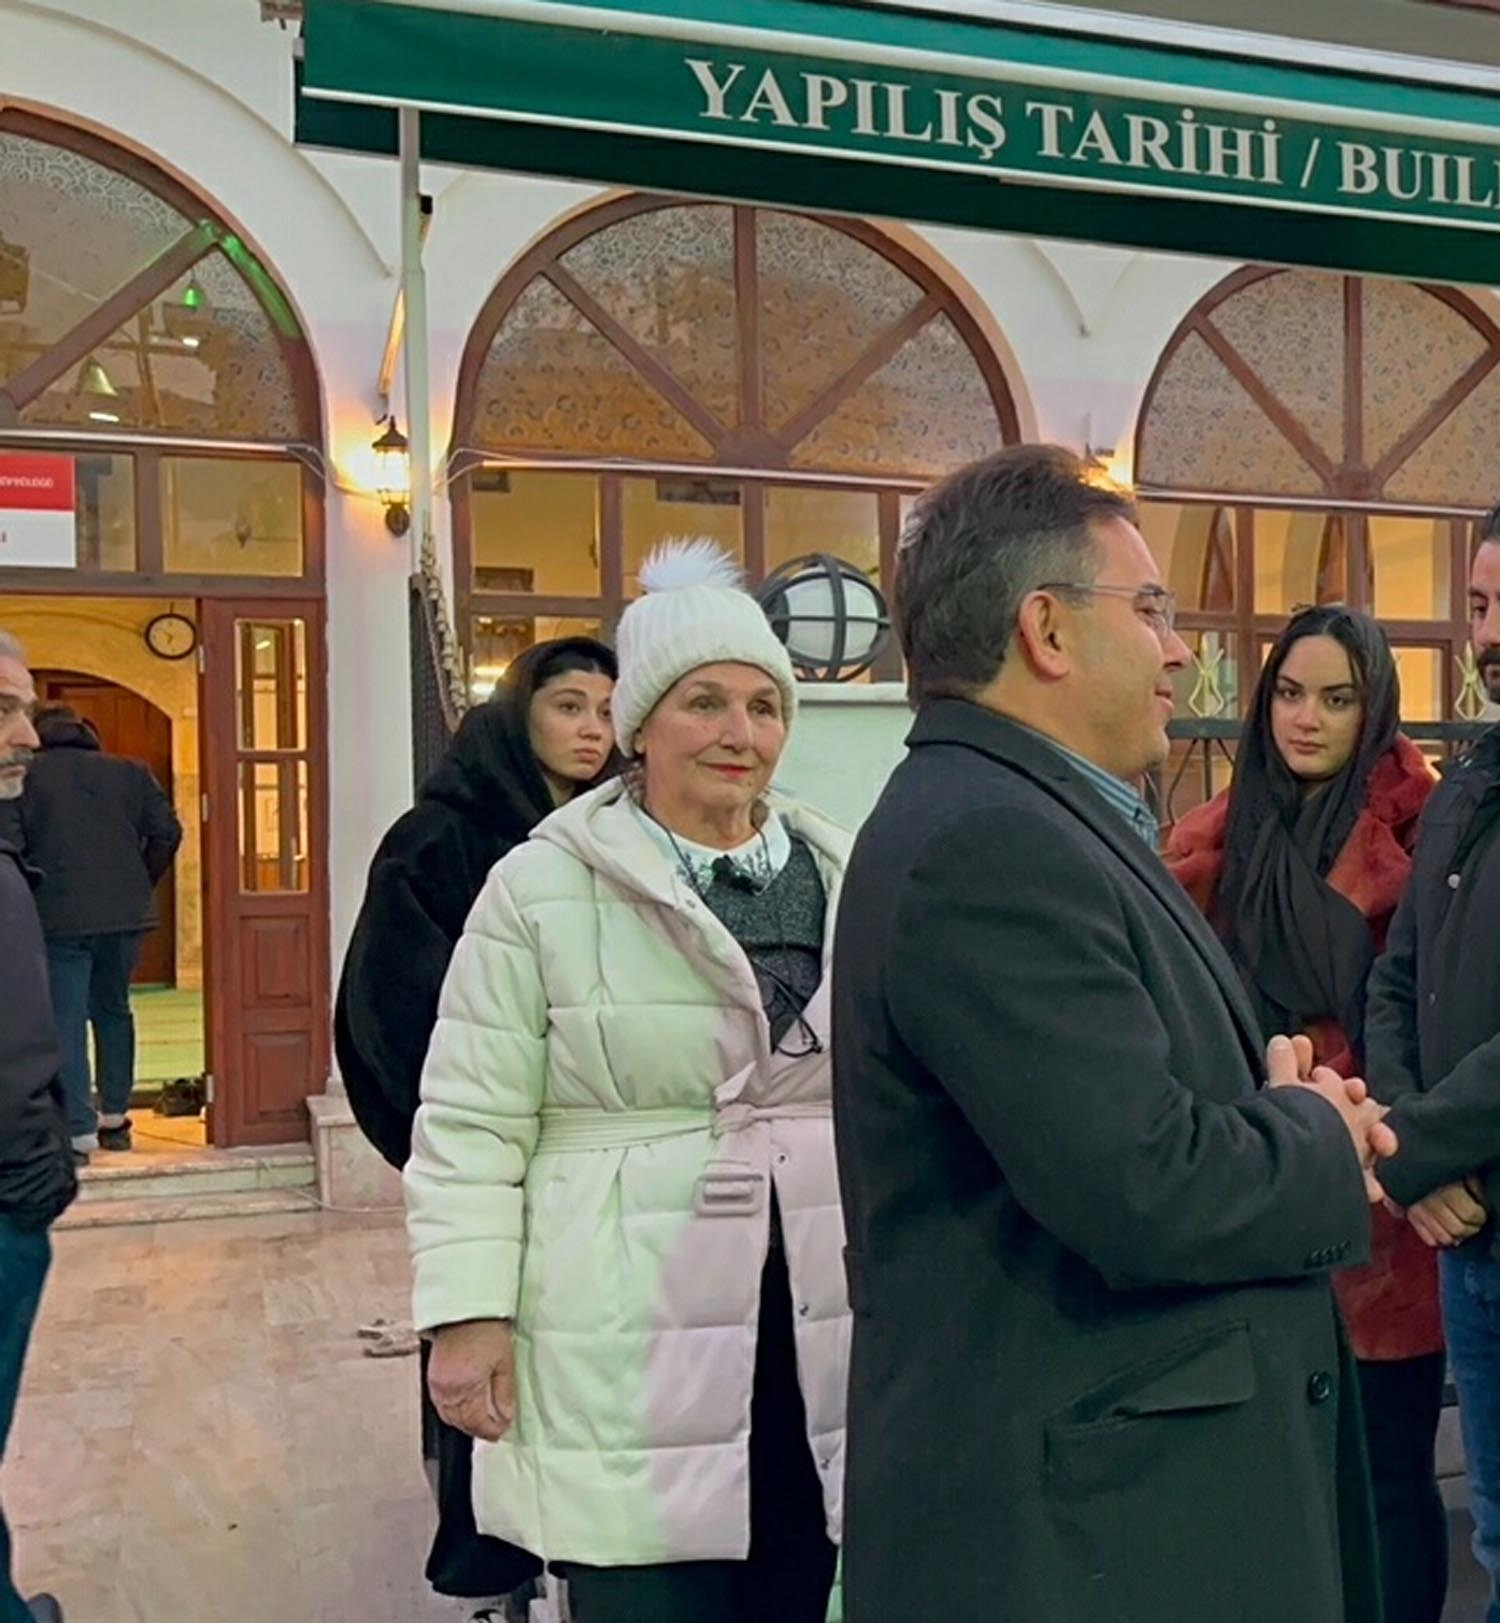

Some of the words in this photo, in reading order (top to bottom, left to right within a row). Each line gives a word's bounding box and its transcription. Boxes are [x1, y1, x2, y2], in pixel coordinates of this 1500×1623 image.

[684, 58, 1006, 160] YAPILIŞ
[1026, 100, 1284, 185] TARİHİ
[1301, 138, 1320, 188] /
